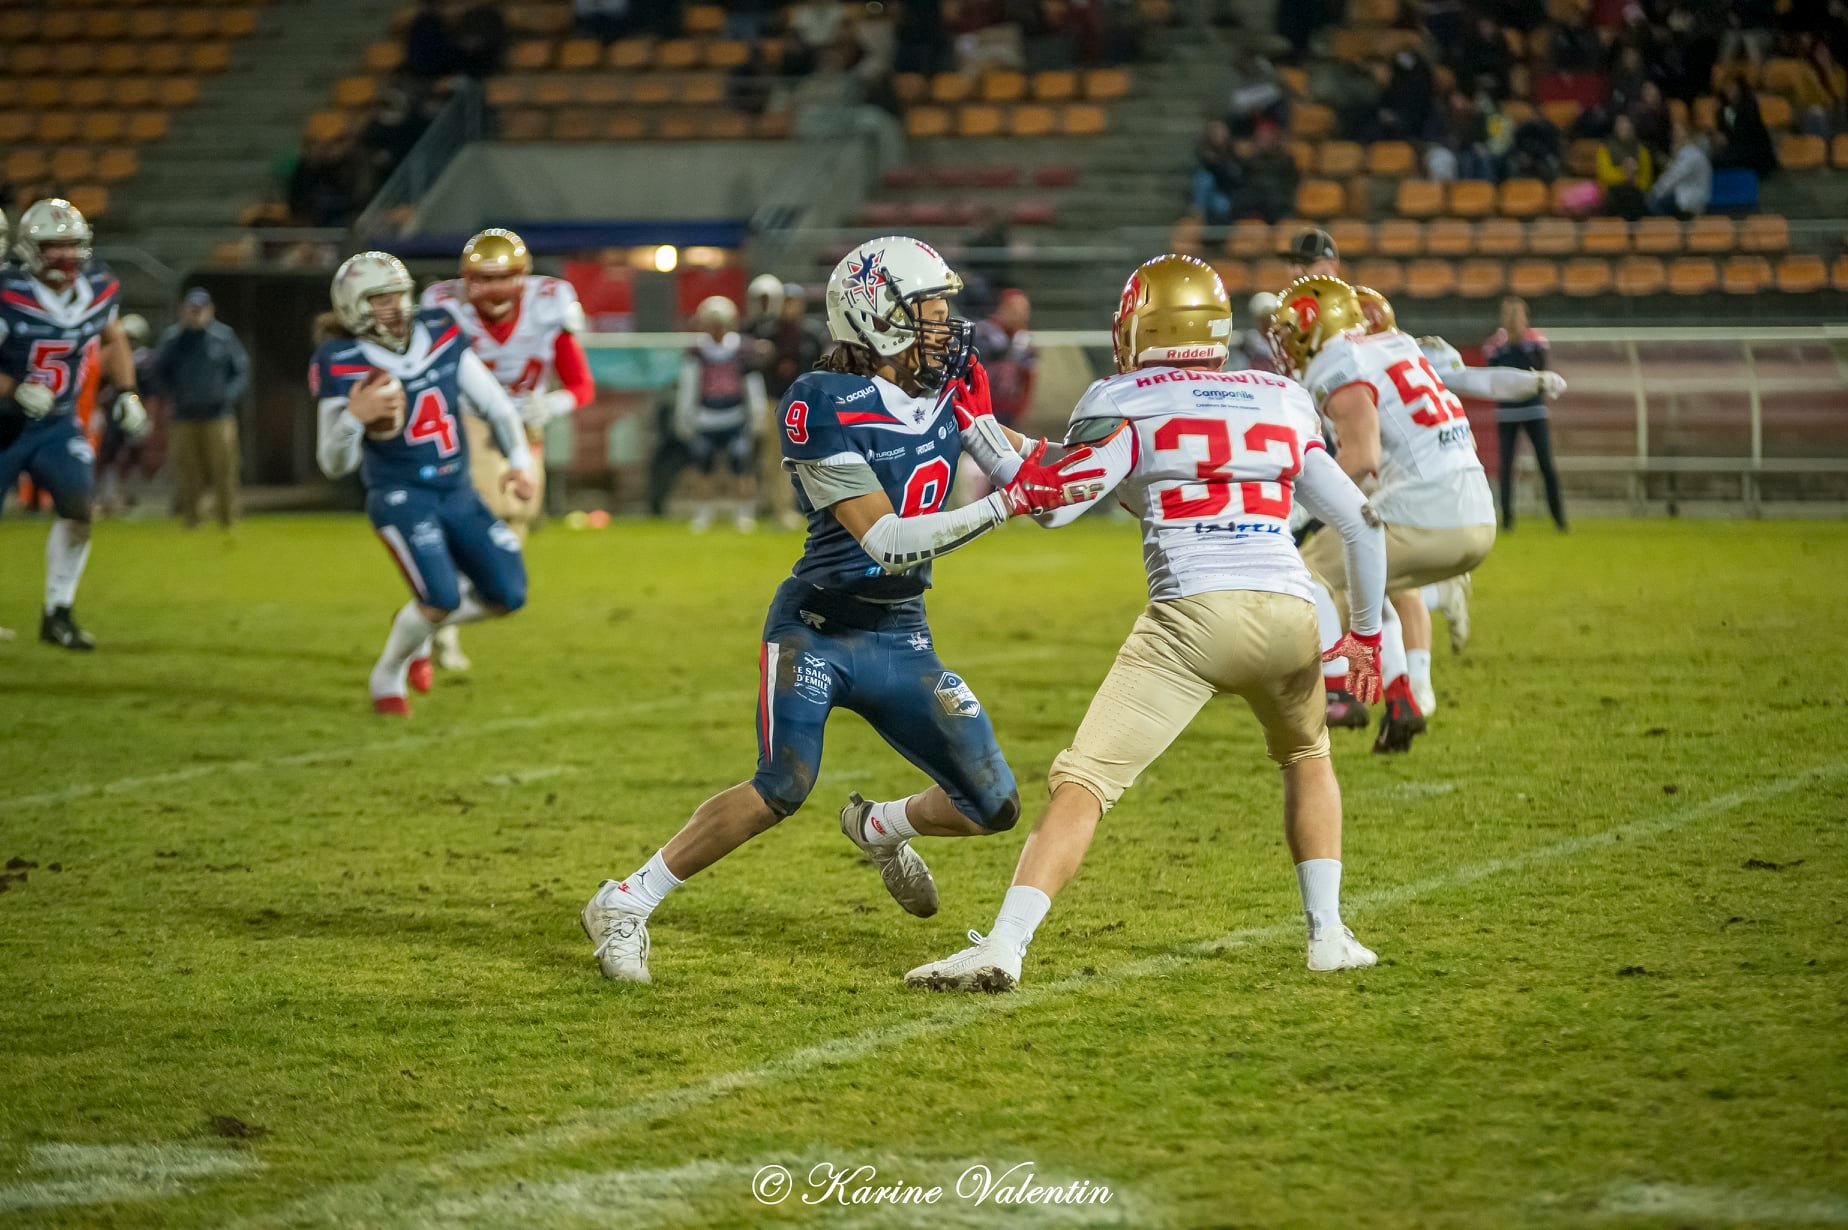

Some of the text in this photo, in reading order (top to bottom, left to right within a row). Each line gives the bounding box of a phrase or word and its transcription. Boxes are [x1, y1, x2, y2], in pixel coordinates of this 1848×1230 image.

[1167, 348, 1215, 360] Riddell
[846, 384, 876, 404] acqua
[1192, 389, 1256, 400] Campanile
[404, 386, 460, 459] 4
[785, 400, 810, 445] 9
[1154, 417, 1303, 521] 33
[805, 667, 832, 686] SALON
